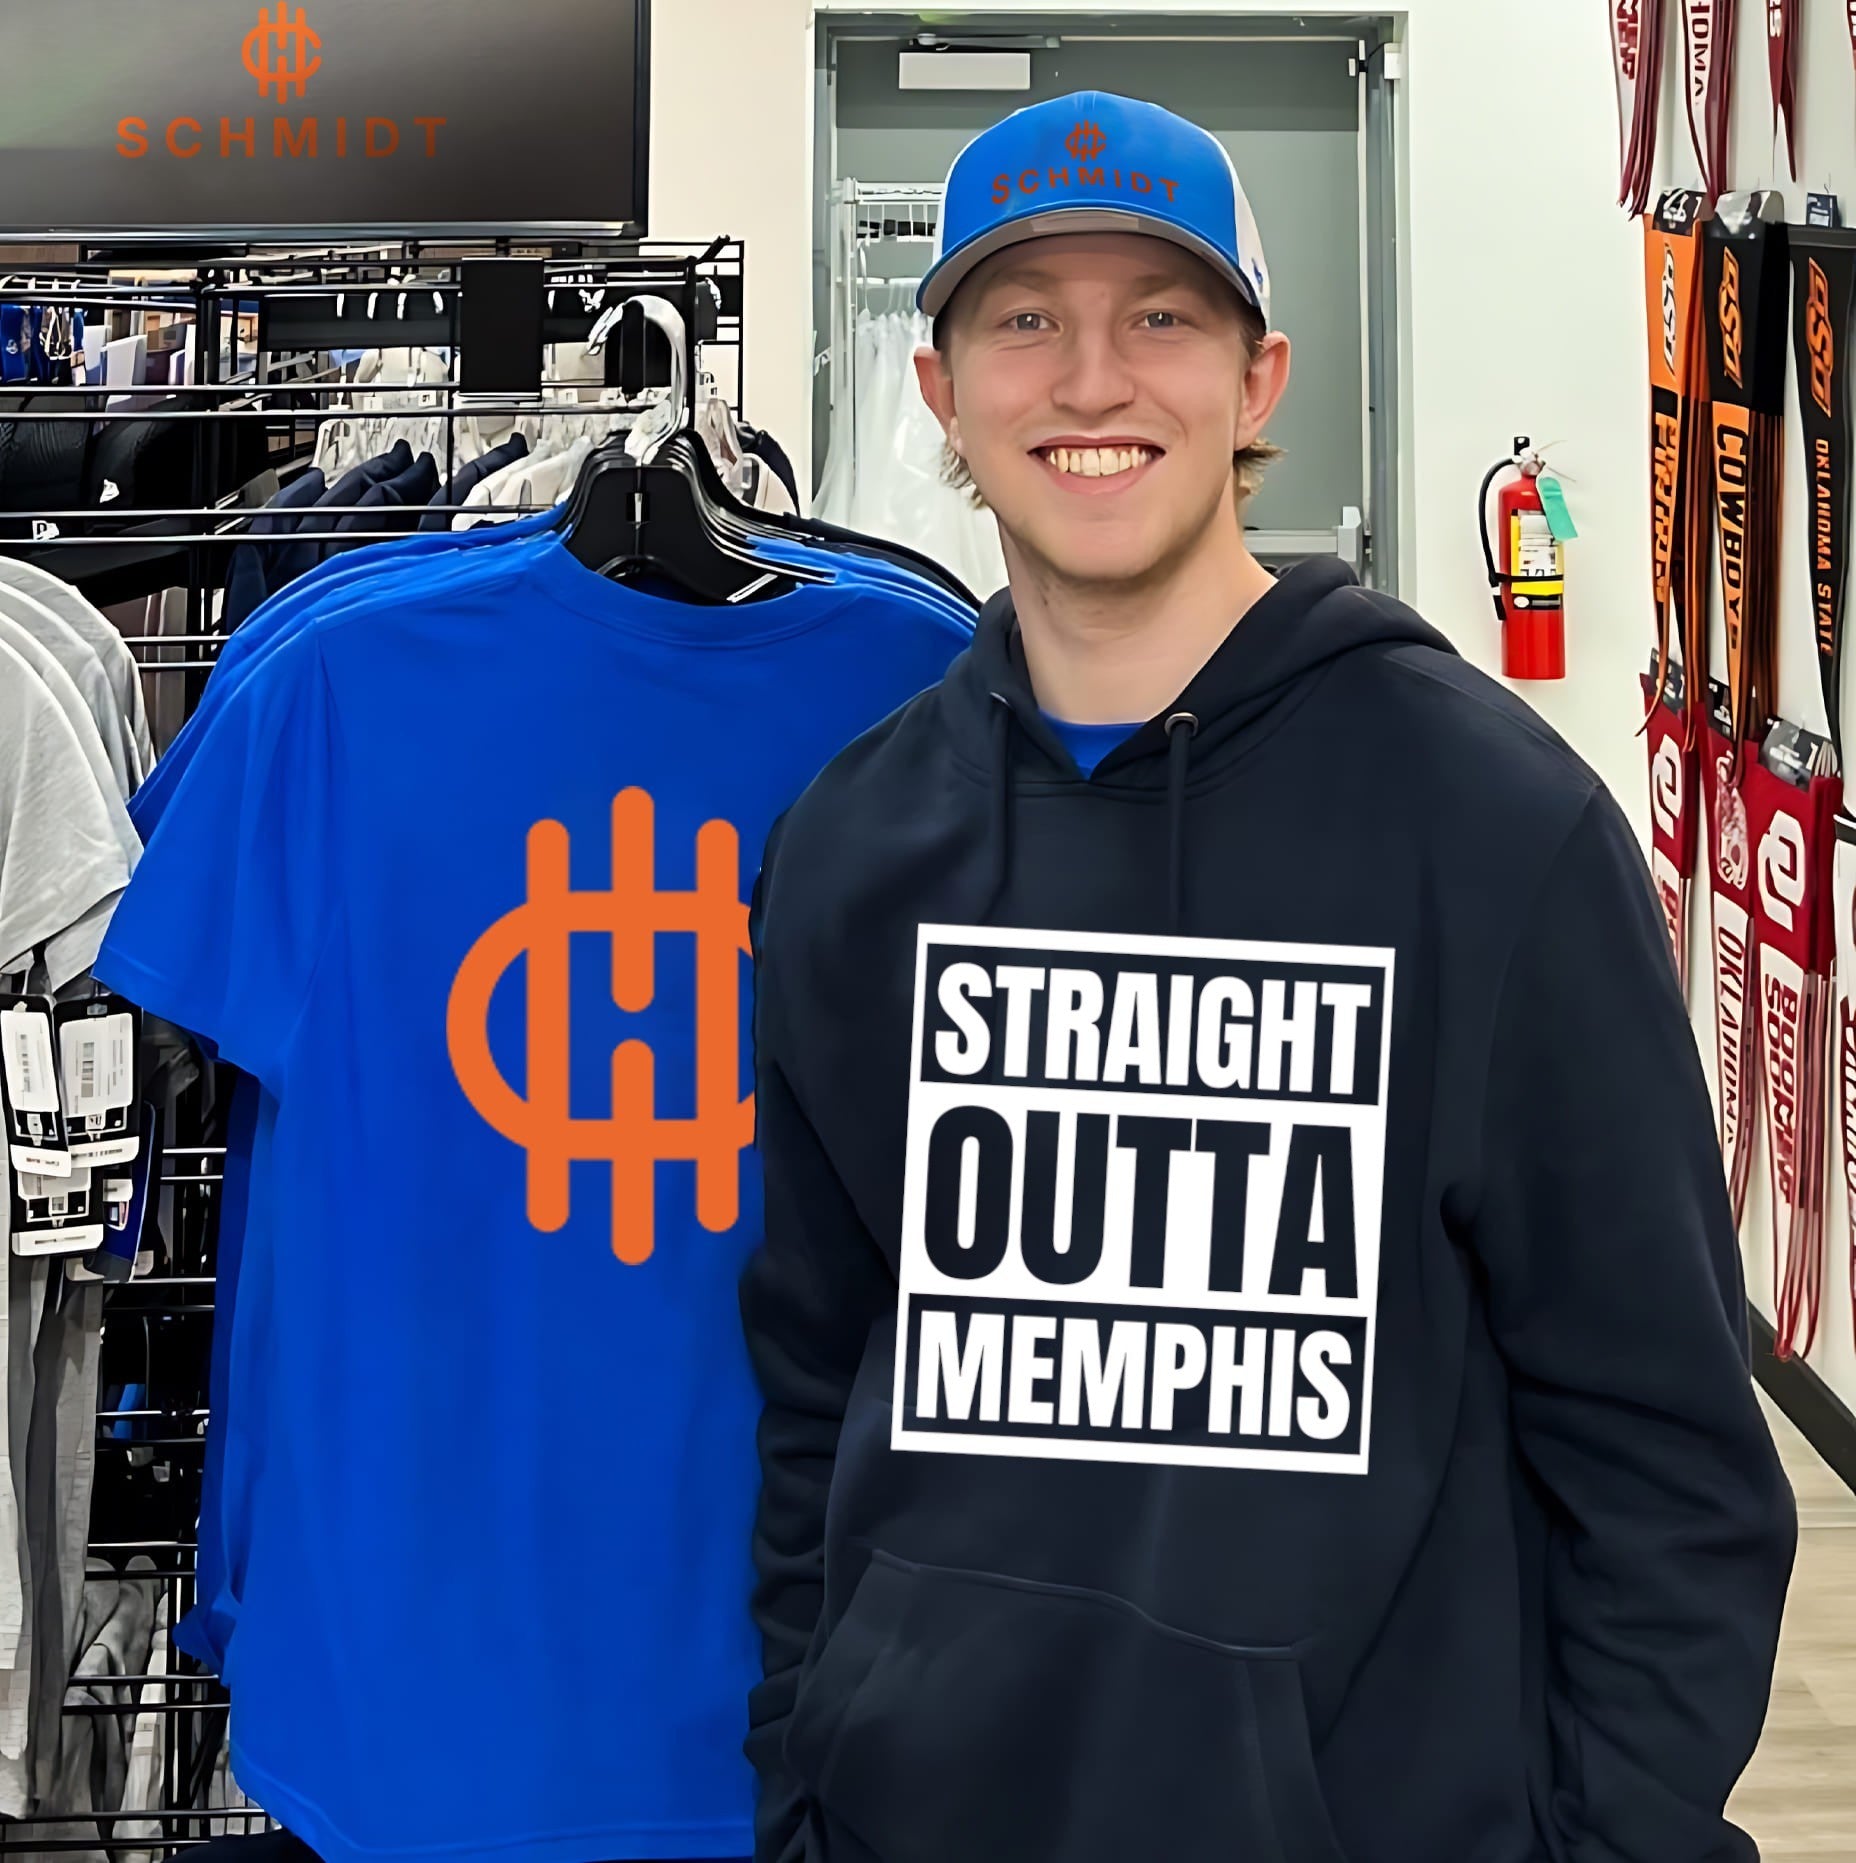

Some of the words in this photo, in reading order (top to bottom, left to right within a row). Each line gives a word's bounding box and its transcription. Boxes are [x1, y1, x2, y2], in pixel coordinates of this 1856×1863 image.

[116, 116, 447, 158] SCHMIDT
[991, 167, 1179, 204] SCHMIDT
[1815, 438, 1832, 571] OKLAHOMA
[1816, 582, 1834, 656] STATE
[935, 962, 1372, 1094] STRAIGHT
[1718, 926, 1744, 1144] OKLAHOMA
[923, 1105, 1359, 1299] OUTTA
[916, 1310, 1352, 1440] MEMPHIS
